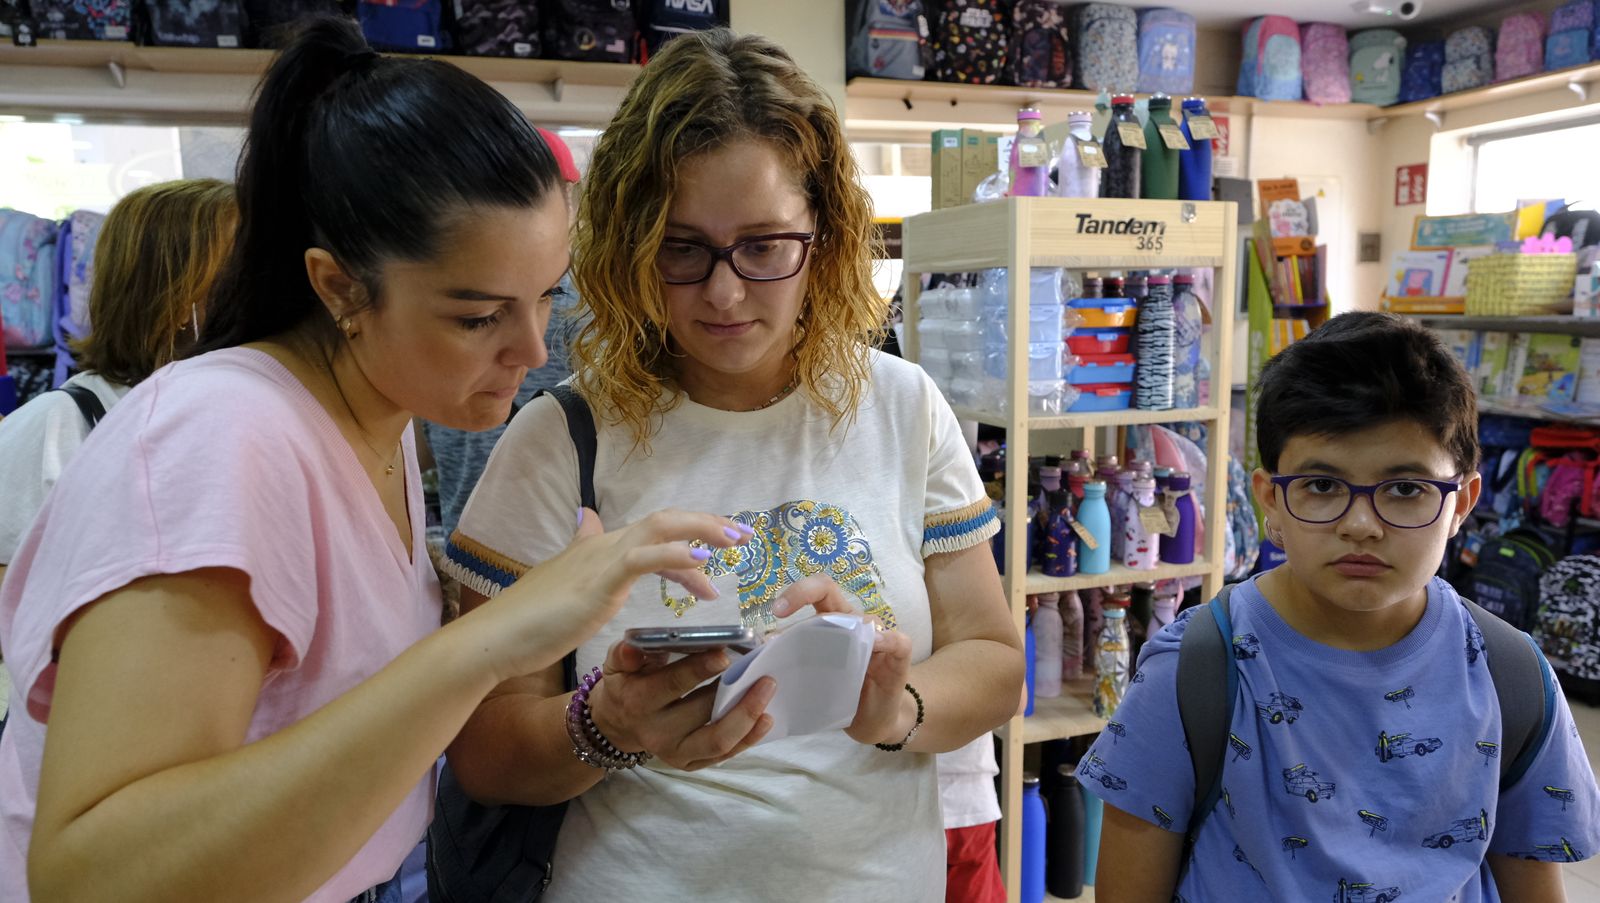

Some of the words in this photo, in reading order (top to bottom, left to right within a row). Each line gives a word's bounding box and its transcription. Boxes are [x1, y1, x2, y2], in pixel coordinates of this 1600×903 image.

[664, 0, 714, 14] NASA
[1075, 213, 1166, 235] Tandem
[1136, 236, 1164, 250] 365
